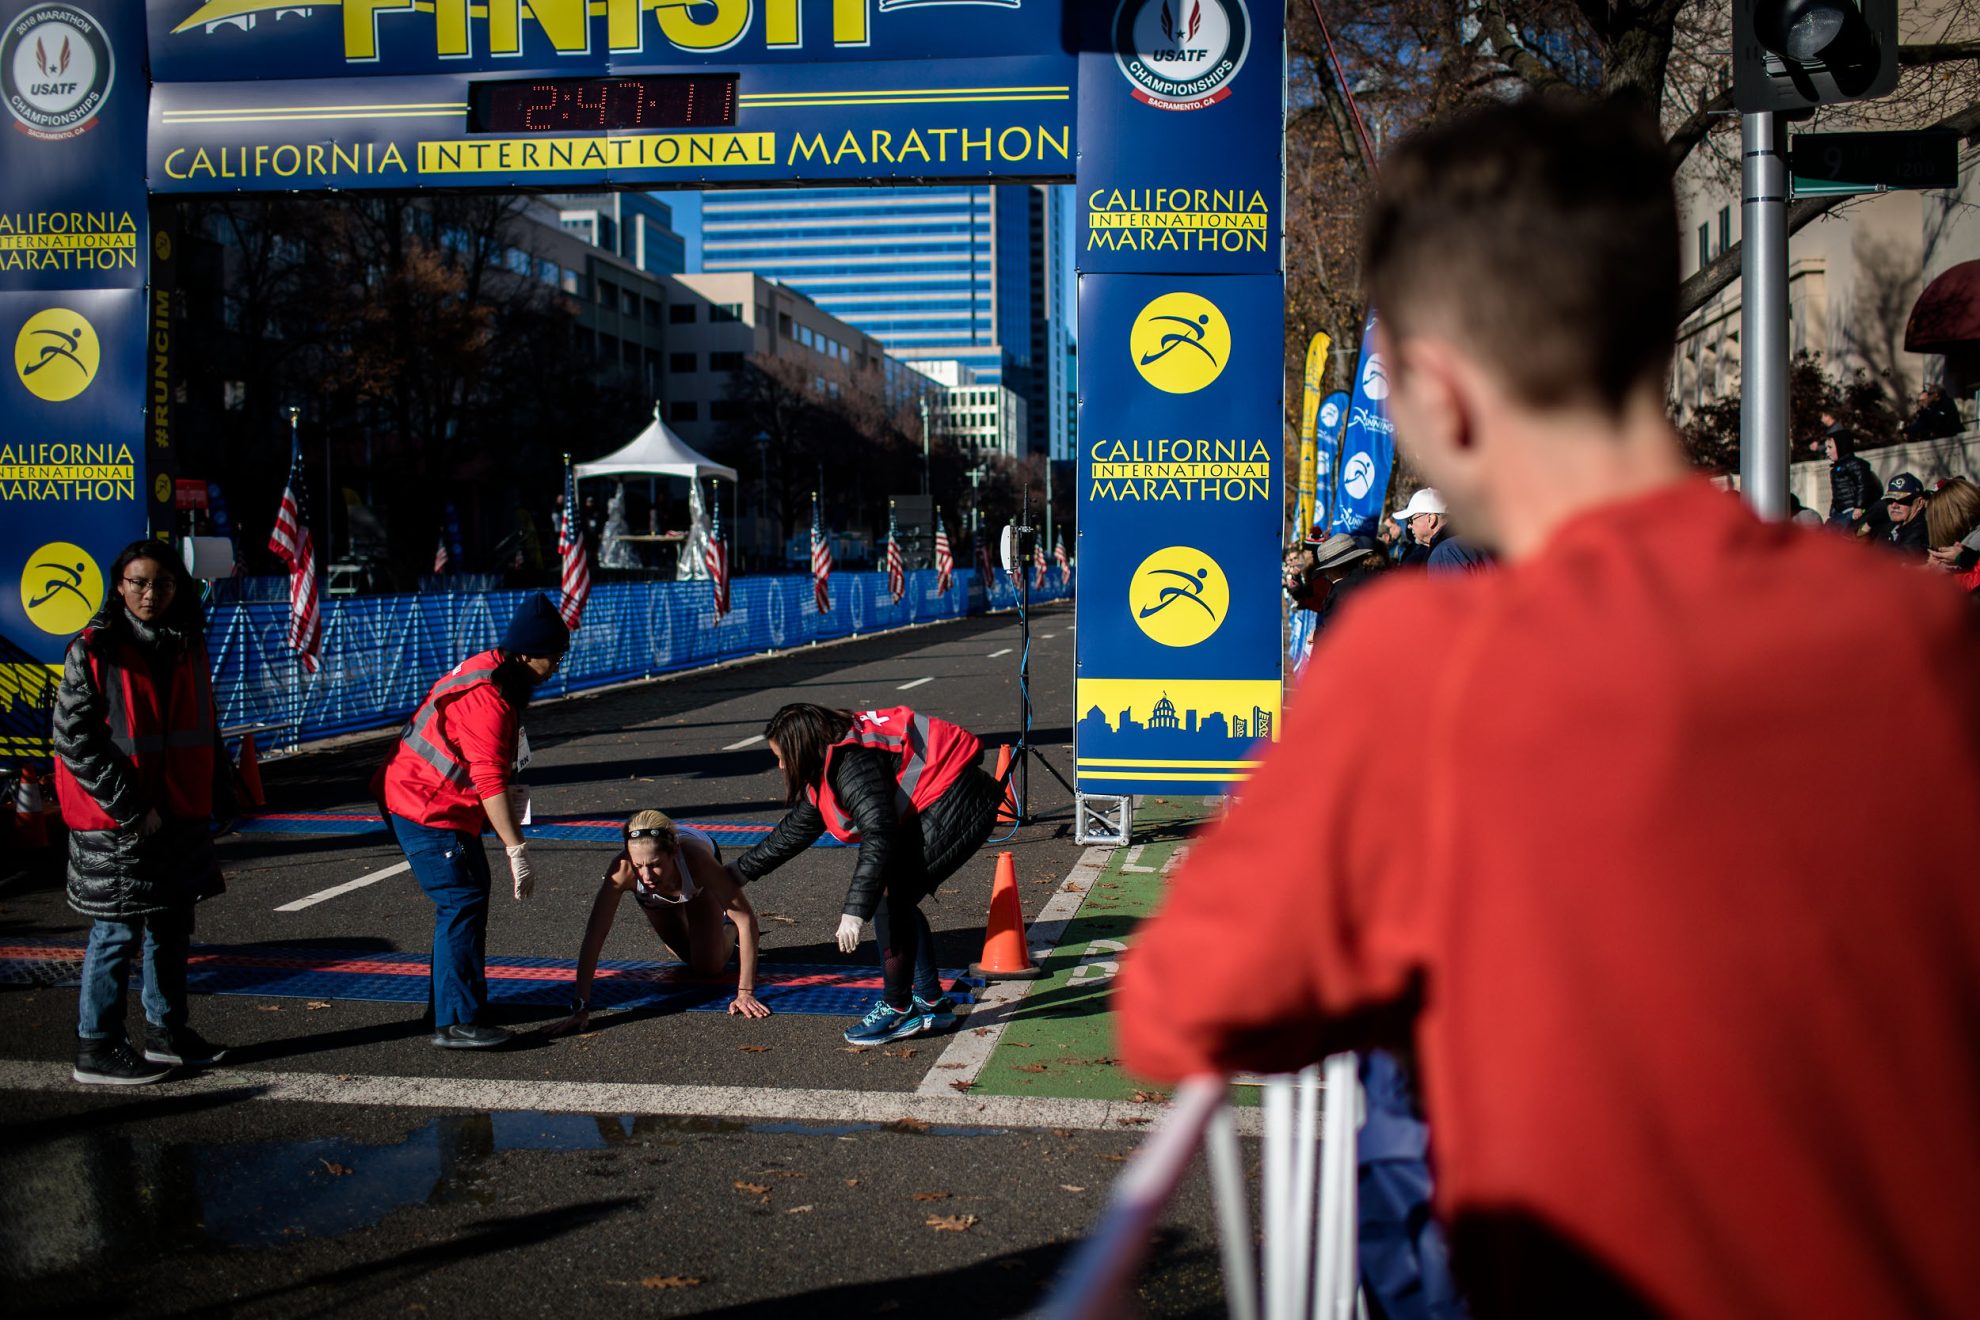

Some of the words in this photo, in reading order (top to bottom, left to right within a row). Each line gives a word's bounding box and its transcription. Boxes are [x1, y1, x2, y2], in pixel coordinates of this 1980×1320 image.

[16, 15, 36, 35] 2018
[36, 10, 91, 33] MARATHON
[1153, 49, 1208, 62] USATF
[1130, 59, 1233, 96] CHAMPIONSHIPS
[30, 83, 77, 96] USATF
[11, 91, 100, 126] CHAMPIONSHIPS
[1147, 97, 1203, 111] SACRAMENTO,
[1203, 98, 1216, 107] CA
[27, 127, 74, 139] SACRAMENTO,
[74, 127, 85, 136] CA
[164, 142, 408, 180] CALIFORNIA
[421, 135, 771, 170] INTERNATIONAL
[787, 125, 1070, 166] MARATHON
[1088, 188, 1269, 212] CALIFORNIA
[0, 211, 137, 234] ALIFORNIA
[1091, 213, 1265, 228] INTERNATIONAL
[0, 235, 134, 248] TERNATIONAL
[1087, 228, 1268, 252] MARATHON
[154, 289, 170, 449] #RUNCIM
[0, 443, 135, 465] ALIFORNIA
[1091, 439, 1271, 462] CALIFORNIA
[1093, 464, 1267, 477] INTERNATIONAL
[1089, 478, 1270, 501] MARATHON
[520, 755, 529, 768] RN
